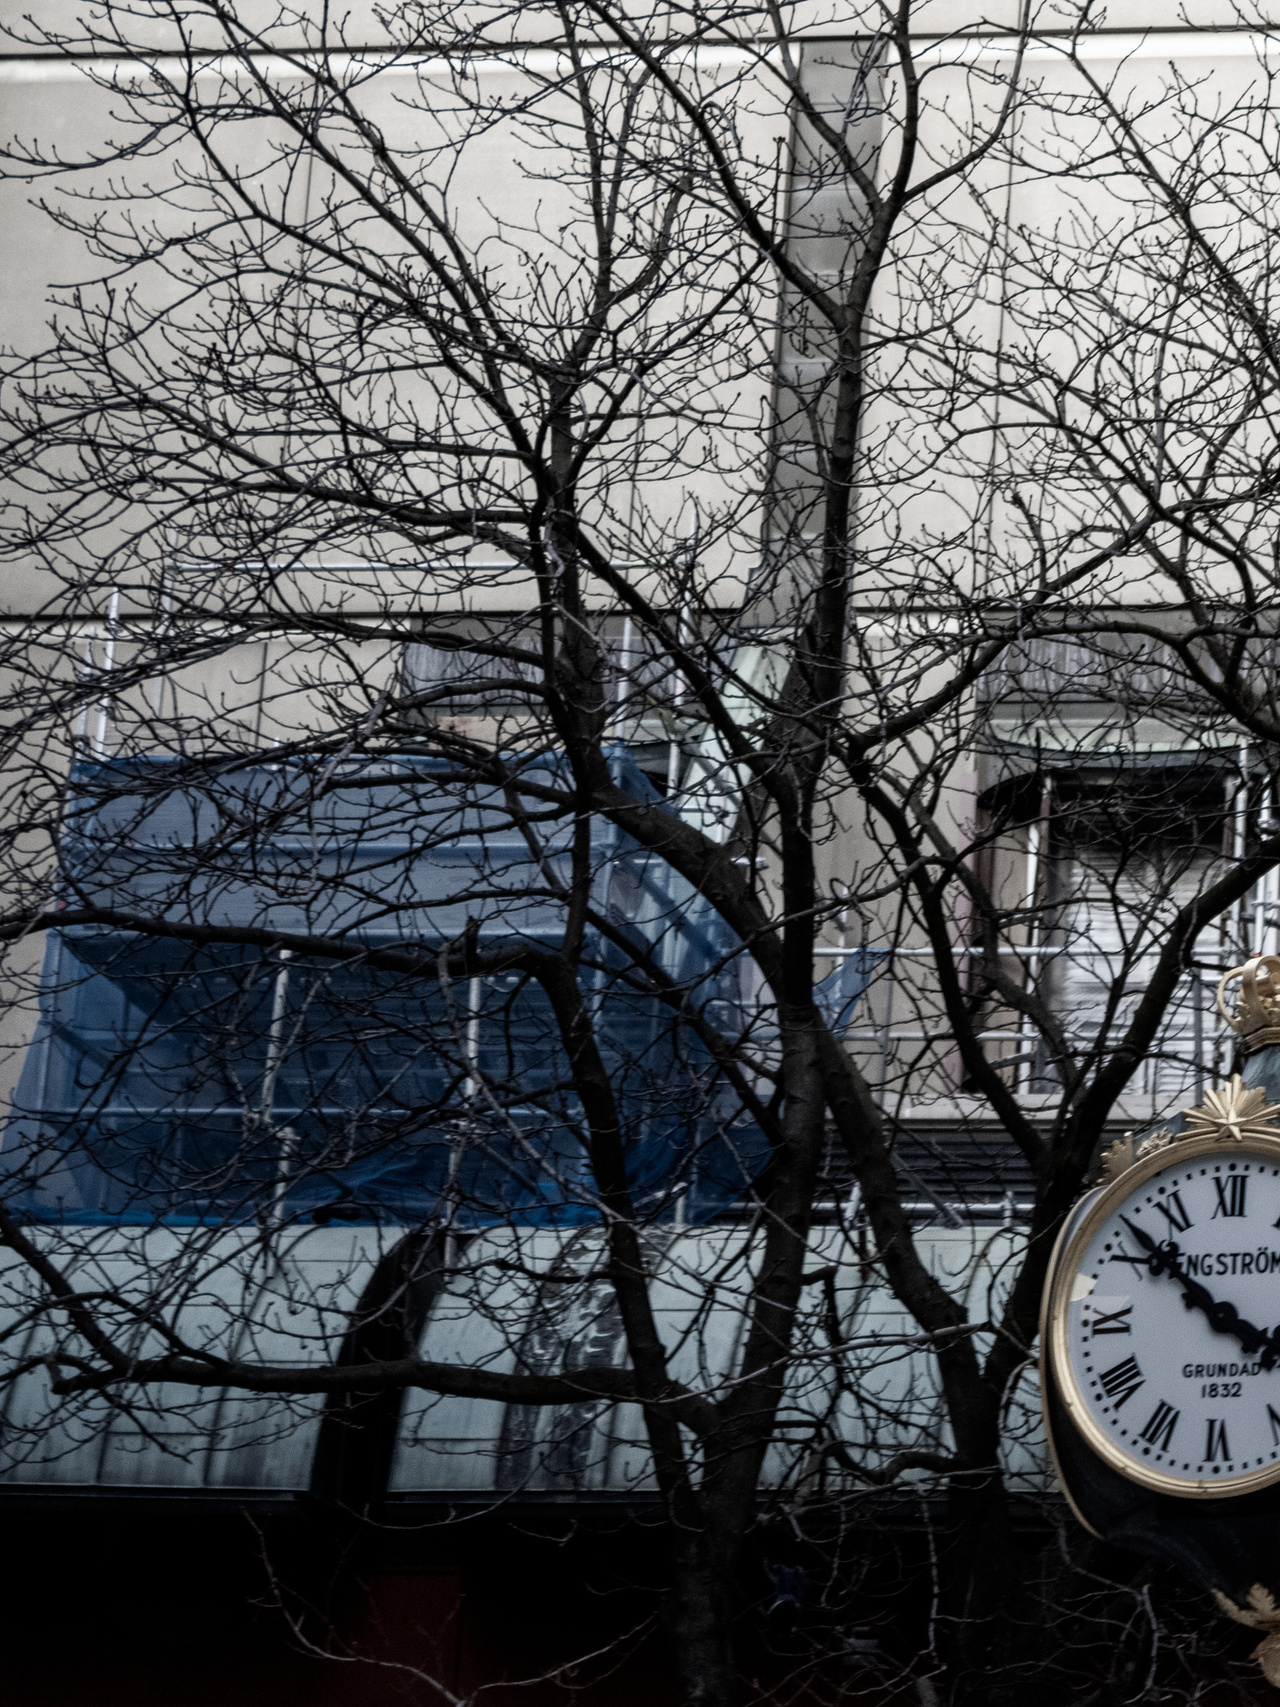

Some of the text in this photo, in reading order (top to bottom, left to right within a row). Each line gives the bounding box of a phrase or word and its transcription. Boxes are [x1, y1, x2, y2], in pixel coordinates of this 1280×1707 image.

[1152, 1189, 1195, 1241] XI
[1211, 1174, 1250, 1219] XII
[1108, 1241, 1152, 1281] X
[1091, 1304, 1134, 1336] IX
[1099, 1352, 1146, 1411] VIII
[1182, 1362, 1262, 1378] GRUNDAD
[1201, 1382, 1243, 1398] 1832
[1138, 1399, 1181, 1454] VII
[1202, 1418, 1233, 1463] VI
